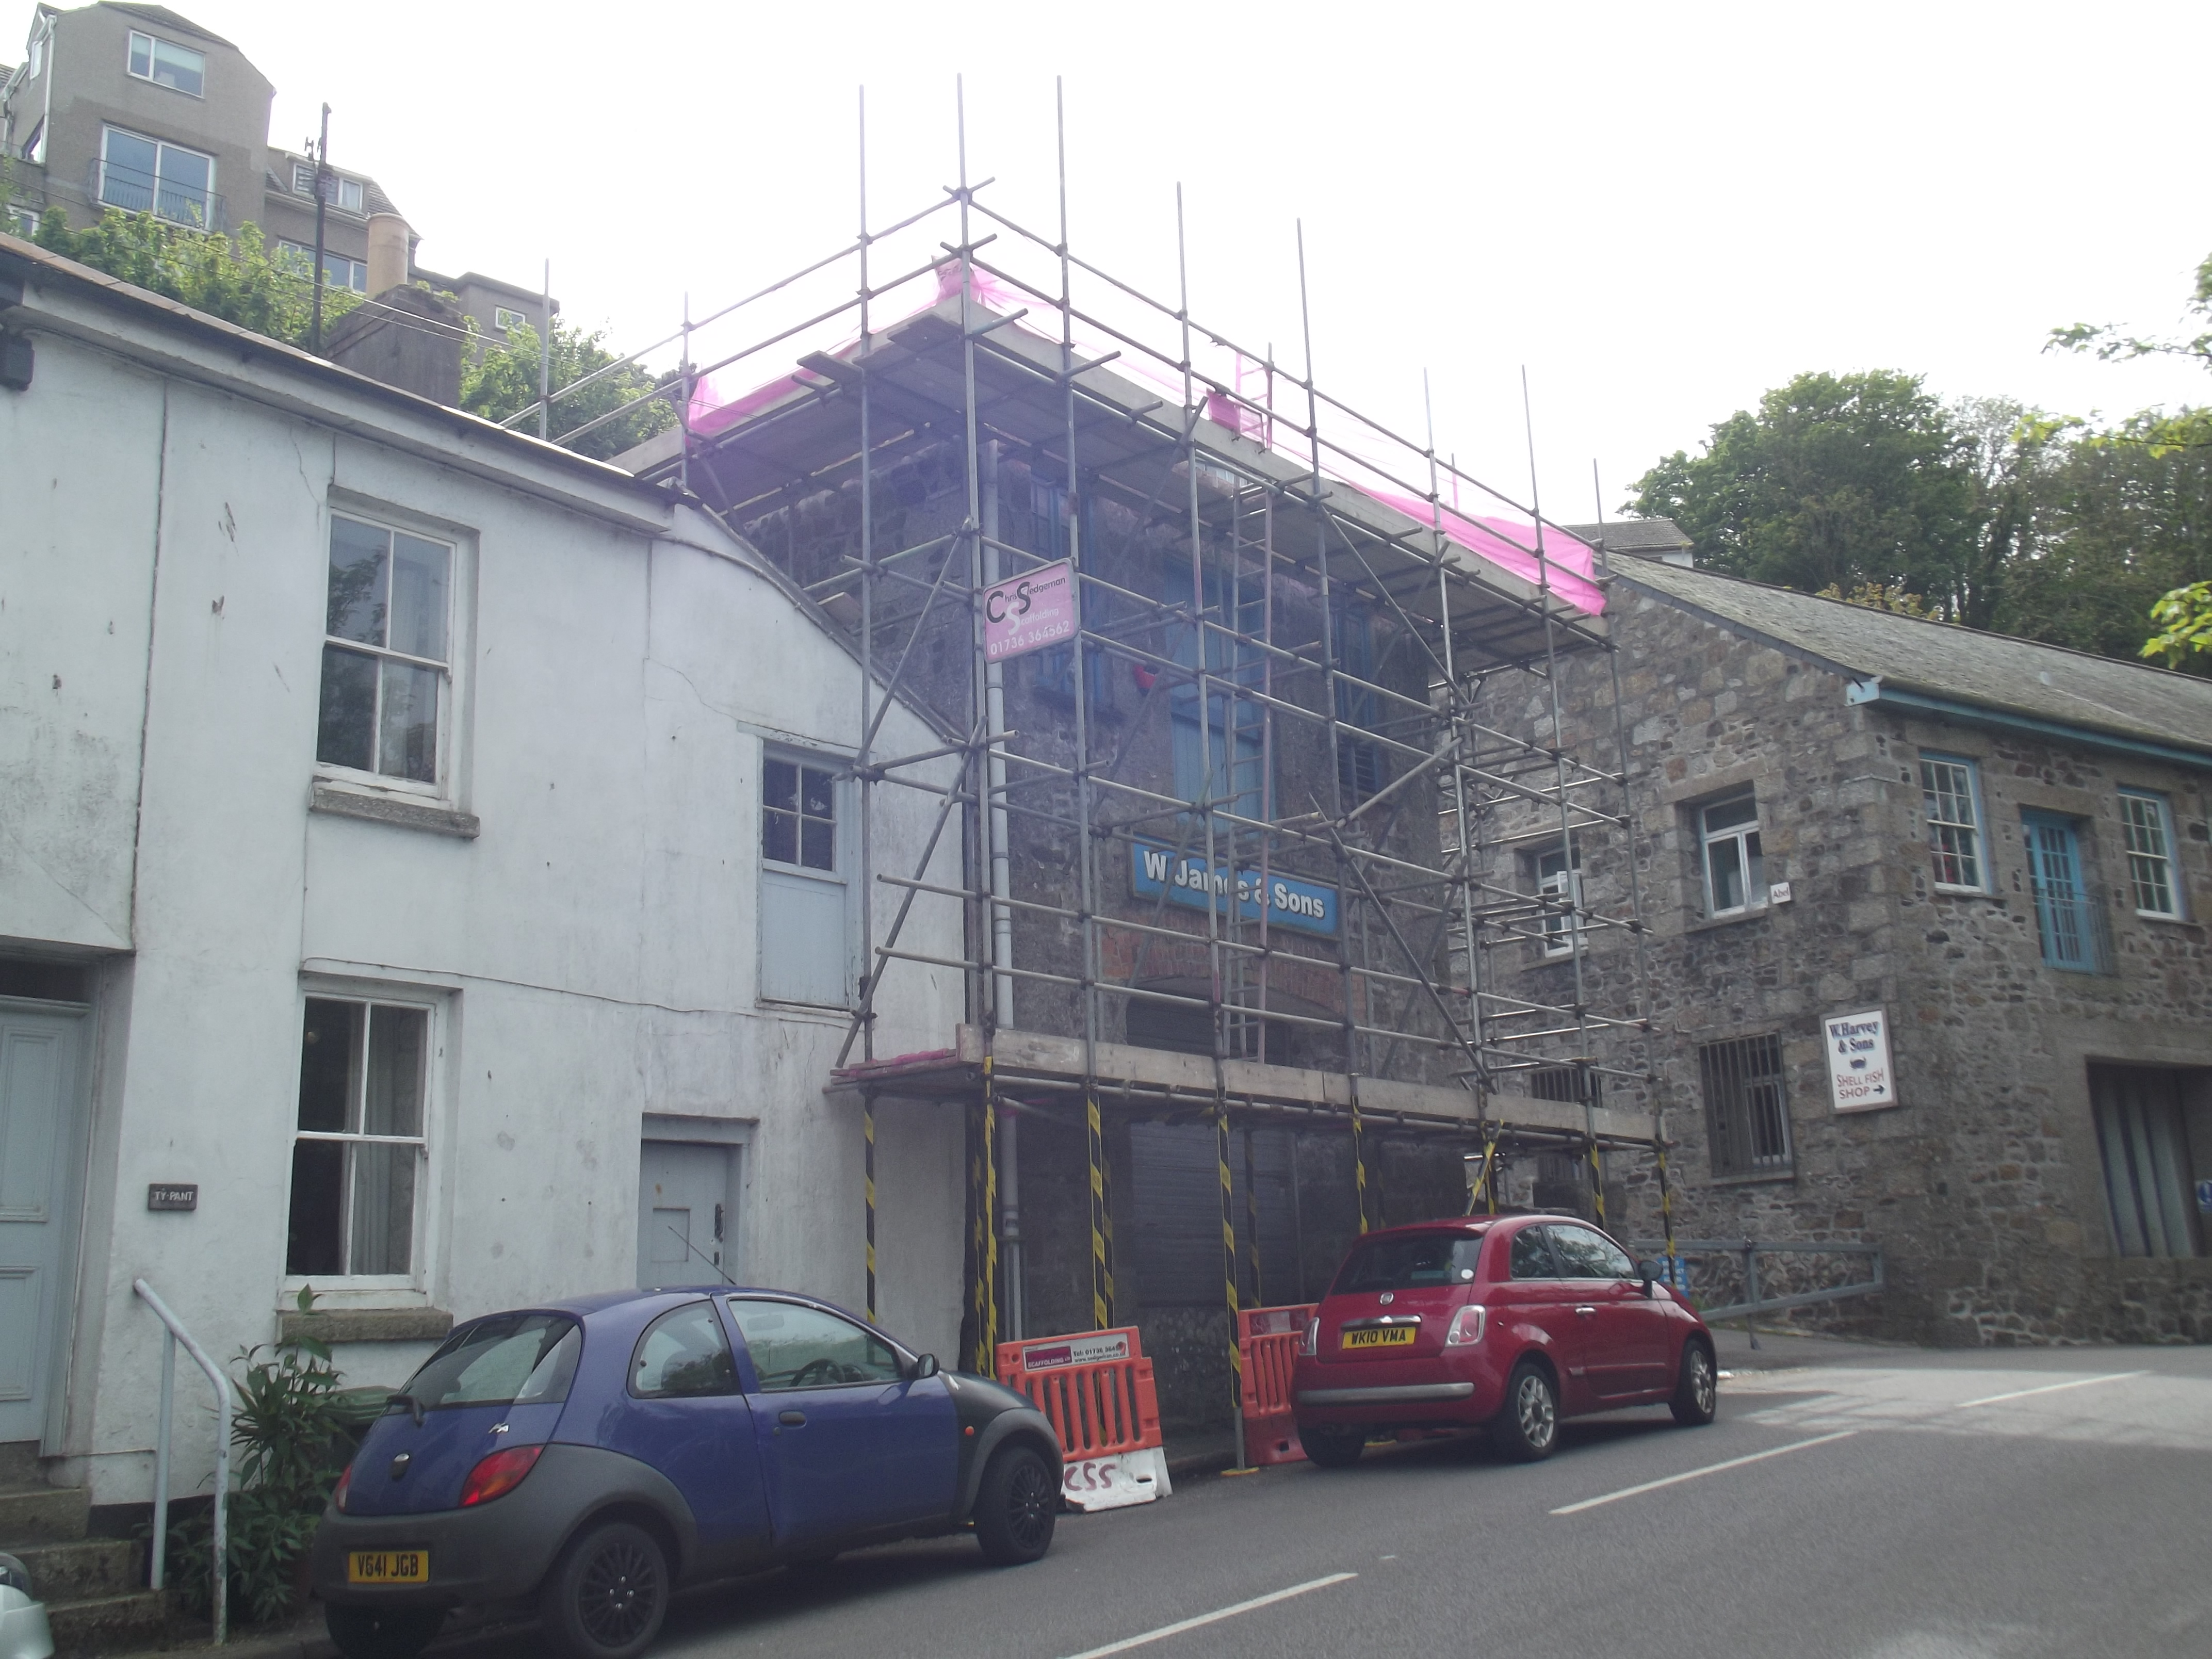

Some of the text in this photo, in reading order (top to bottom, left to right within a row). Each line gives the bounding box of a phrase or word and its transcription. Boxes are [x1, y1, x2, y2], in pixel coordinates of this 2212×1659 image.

[986, 577, 1066, 623] Chris Sedgeman
[1006, 601, 1059, 636] Scaffolding
[990, 620, 1069, 655] 01736 364562
[1144, 850, 1167, 882] W
[1175, 860, 1249, 901] Jams
[1274, 882, 1325, 918] Sons
[1774, 887, 1790, 898] Abel
[1838, 1037, 1874, 1053] & Sons
[1837, 1067, 1884, 1087] SHELL FISH
[1839, 1086, 1870, 1099] SHOP
[1352, 1329, 1406, 1345] WK10 VMA
[1028, 1357, 1064, 1369] SCAFFOLDING
[358, 1554, 419, 1577] V641 JGB
